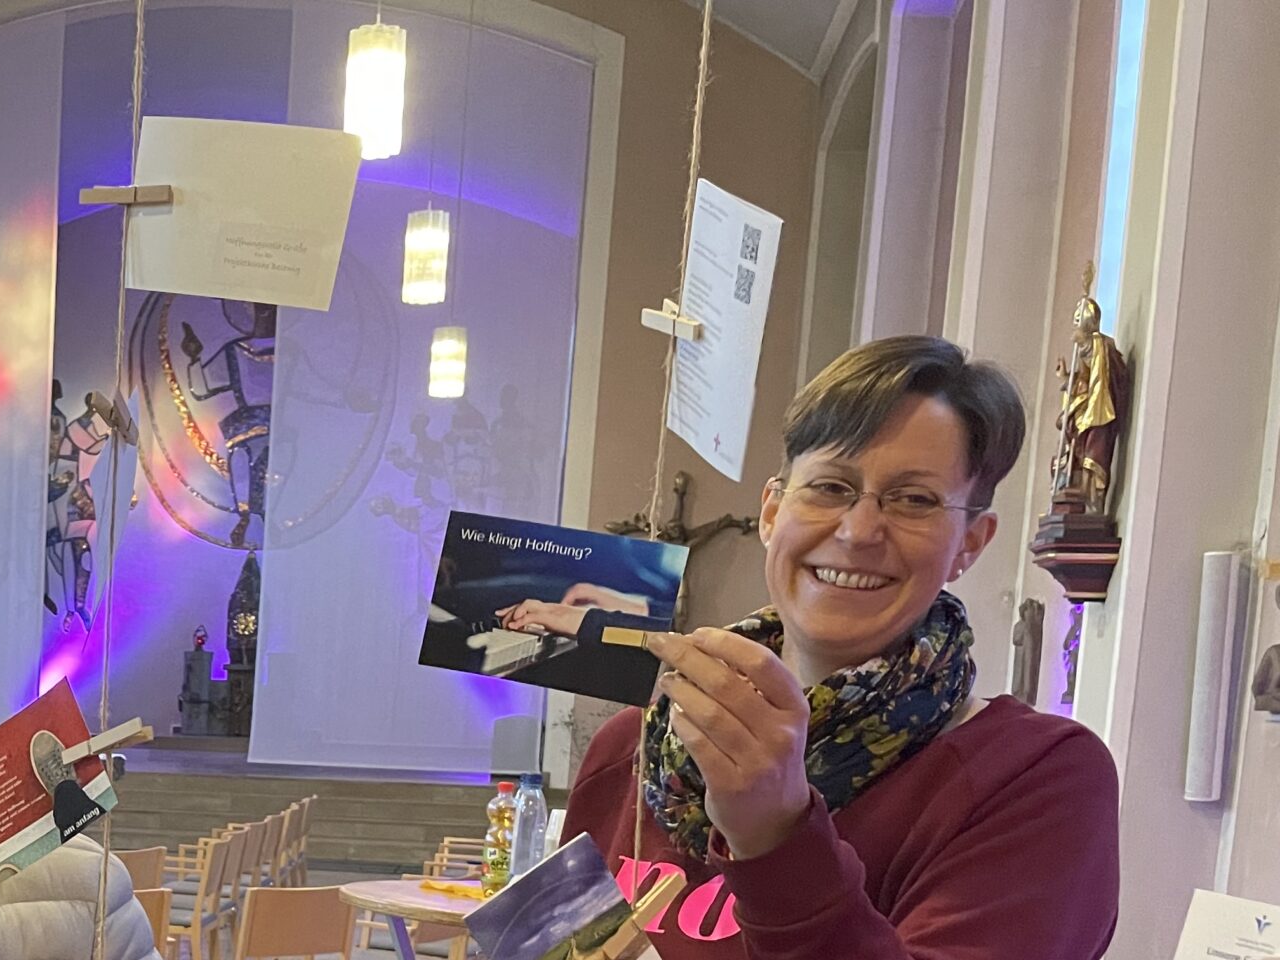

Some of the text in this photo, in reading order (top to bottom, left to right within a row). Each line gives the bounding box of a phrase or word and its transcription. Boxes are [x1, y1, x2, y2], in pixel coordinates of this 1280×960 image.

[461, 528, 592, 560] Wie klingt Hoffnung?
[64, 807, 100, 837] am anfang
